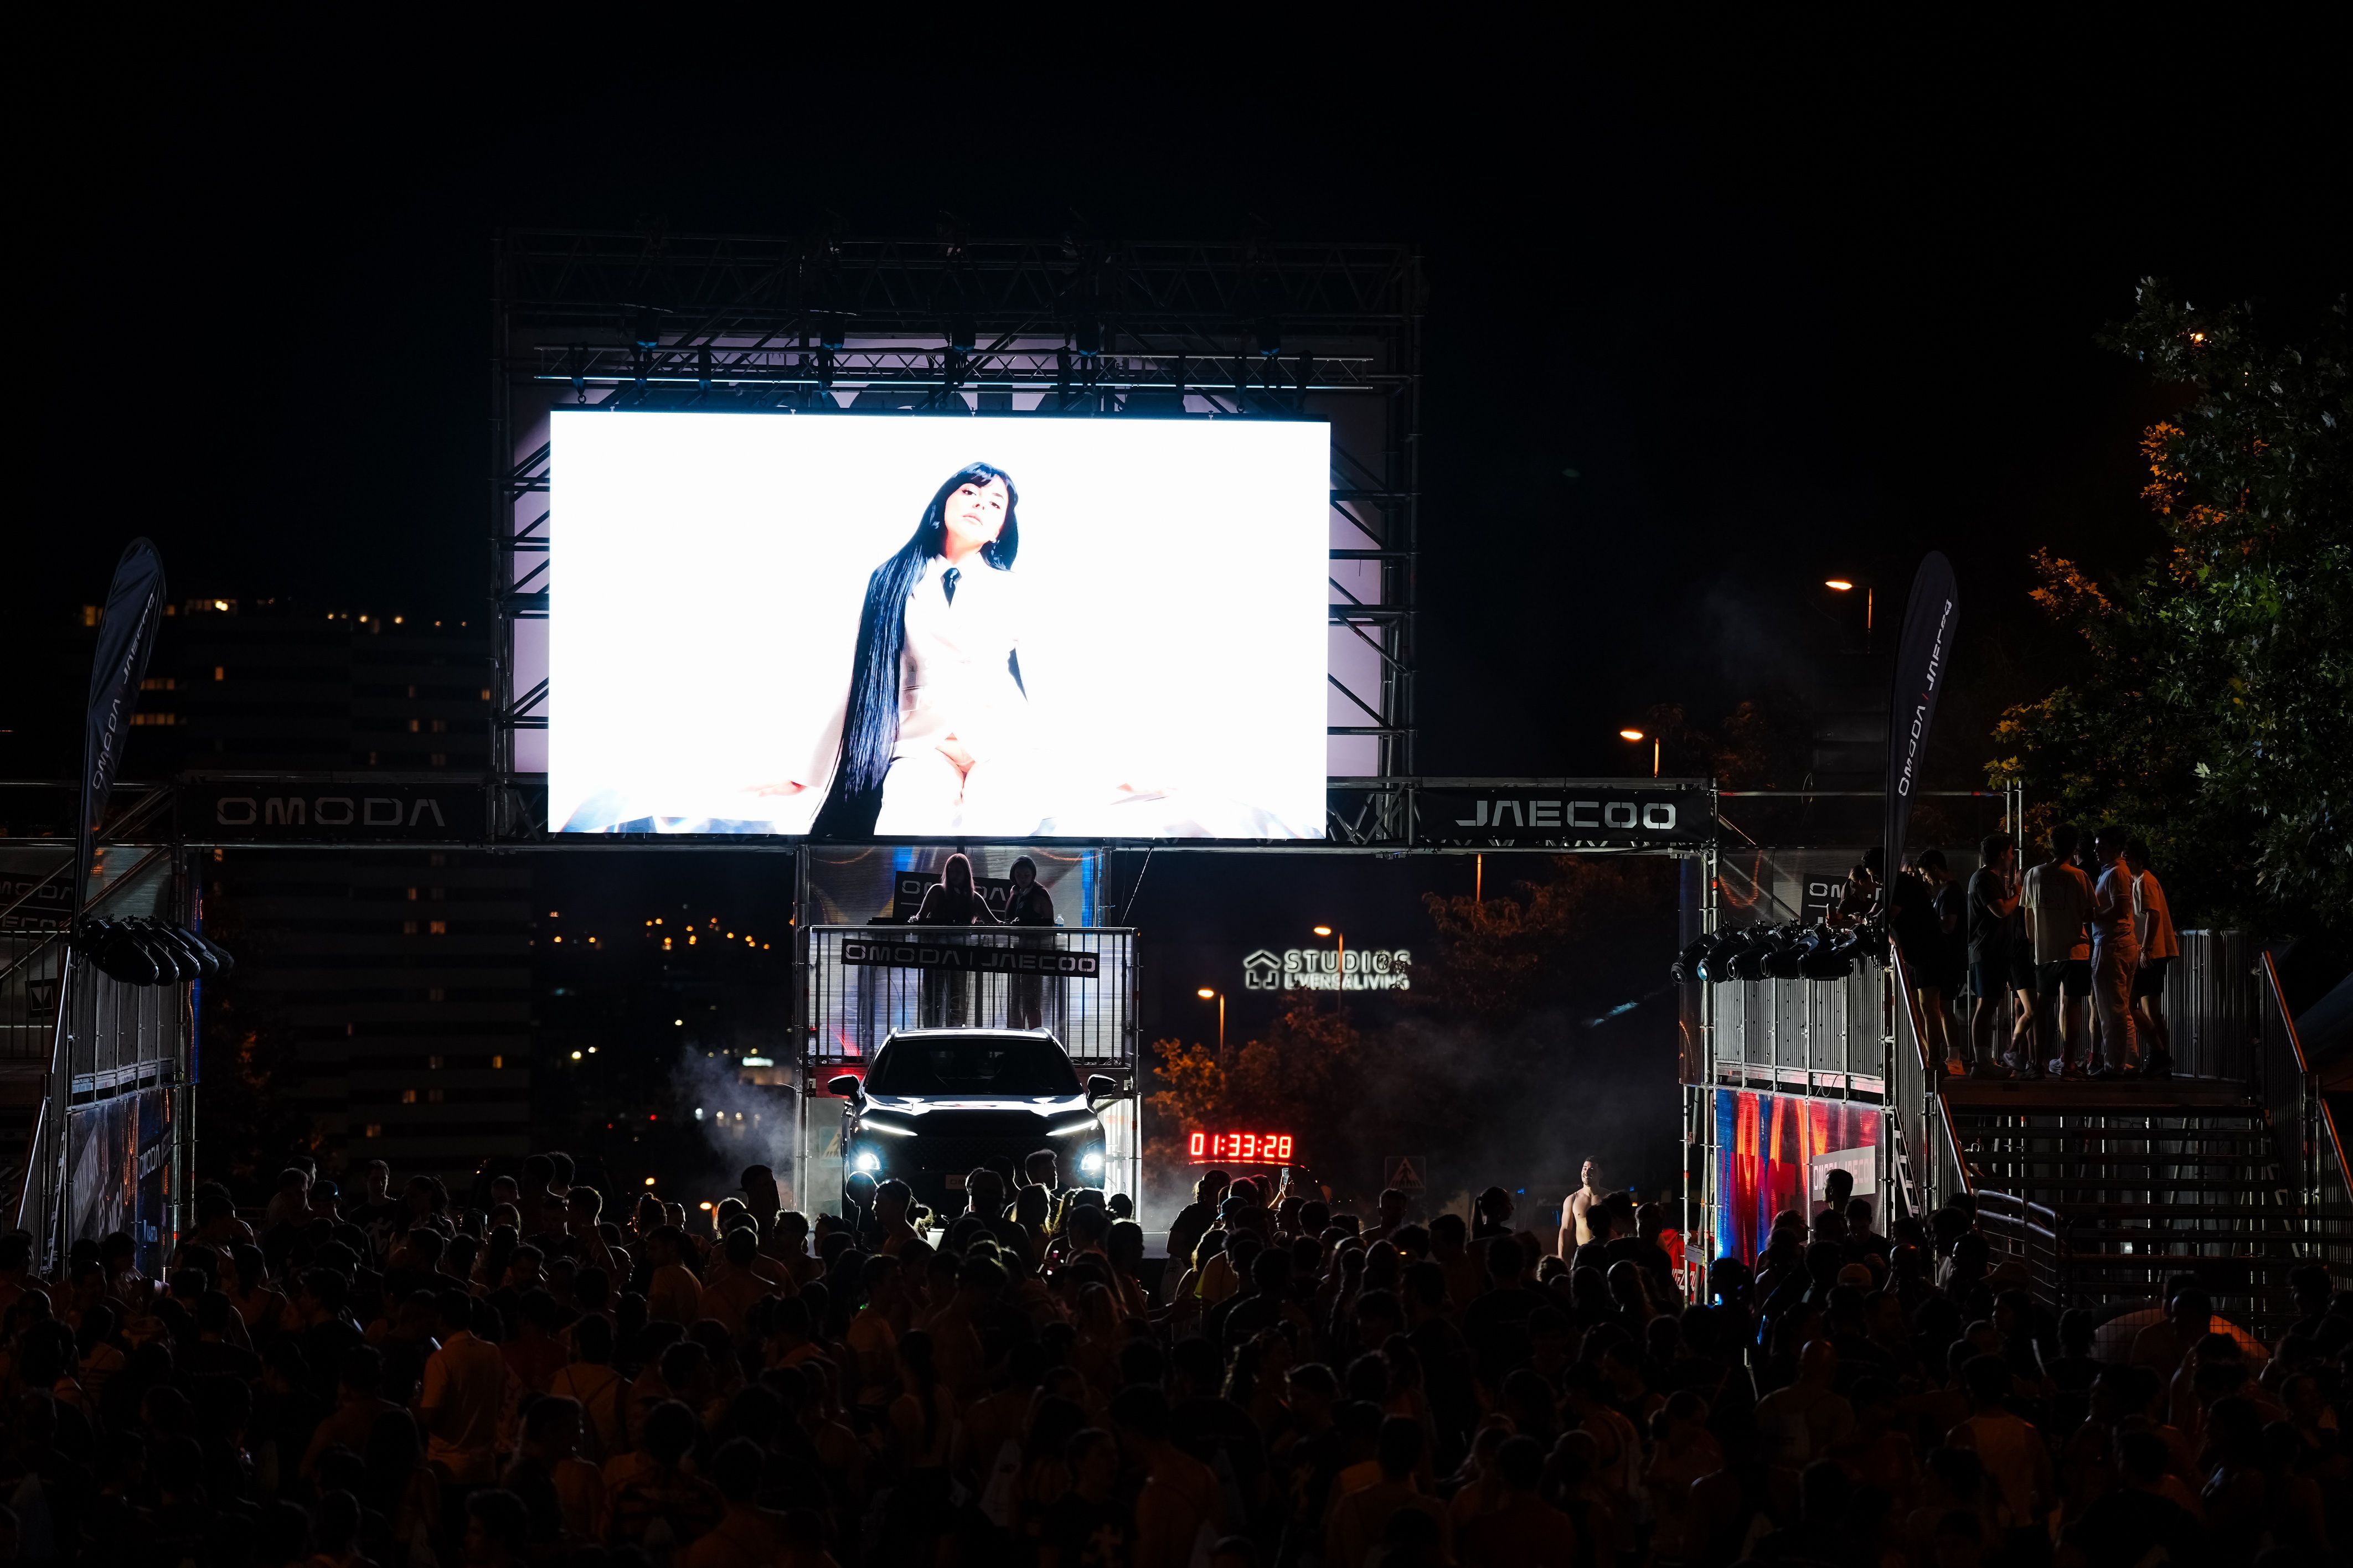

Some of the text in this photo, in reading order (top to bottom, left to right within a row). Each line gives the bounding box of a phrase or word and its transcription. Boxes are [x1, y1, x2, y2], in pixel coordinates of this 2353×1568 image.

[92, 698, 121, 790] OMODA
[1898, 705, 1926, 796] OMODA
[216, 797, 445, 827] OMODA
[1455, 800, 1676, 830] JAECOO
[845, 944, 961, 965] OMODA
[981, 953, 1096, 972] JAECOO
[1190, 1133, 1292, 1158] 01:33:28
[139, 1143, 161, 1181] OMODA
